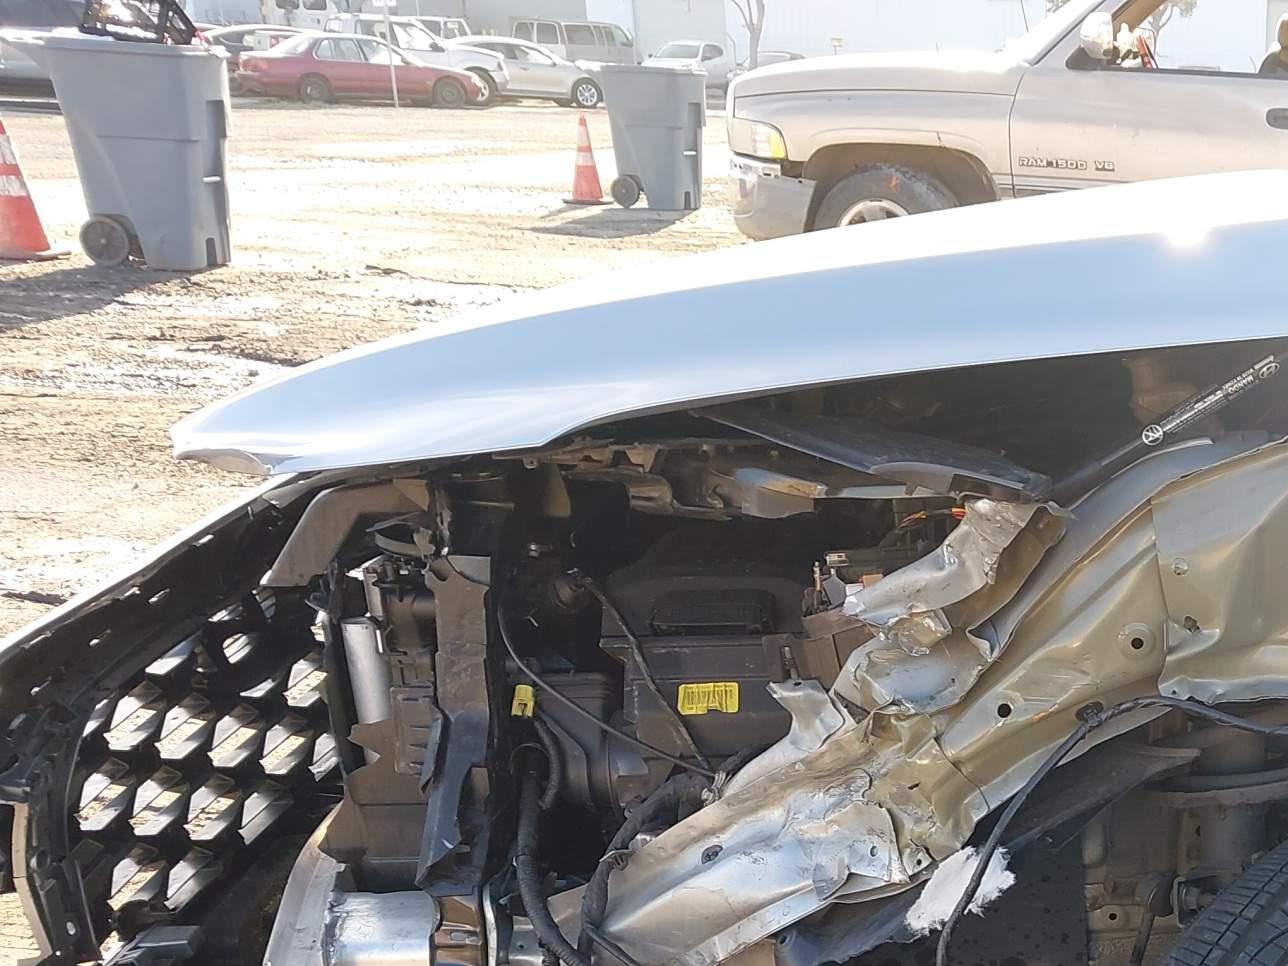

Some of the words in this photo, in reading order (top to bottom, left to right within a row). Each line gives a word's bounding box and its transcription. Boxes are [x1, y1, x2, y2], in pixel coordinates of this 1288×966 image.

[1018, 157, 1047, 168] RAM
[1051, 159, 1088, 170] 1500
[1228, 374, 1255, 394] MANDO
